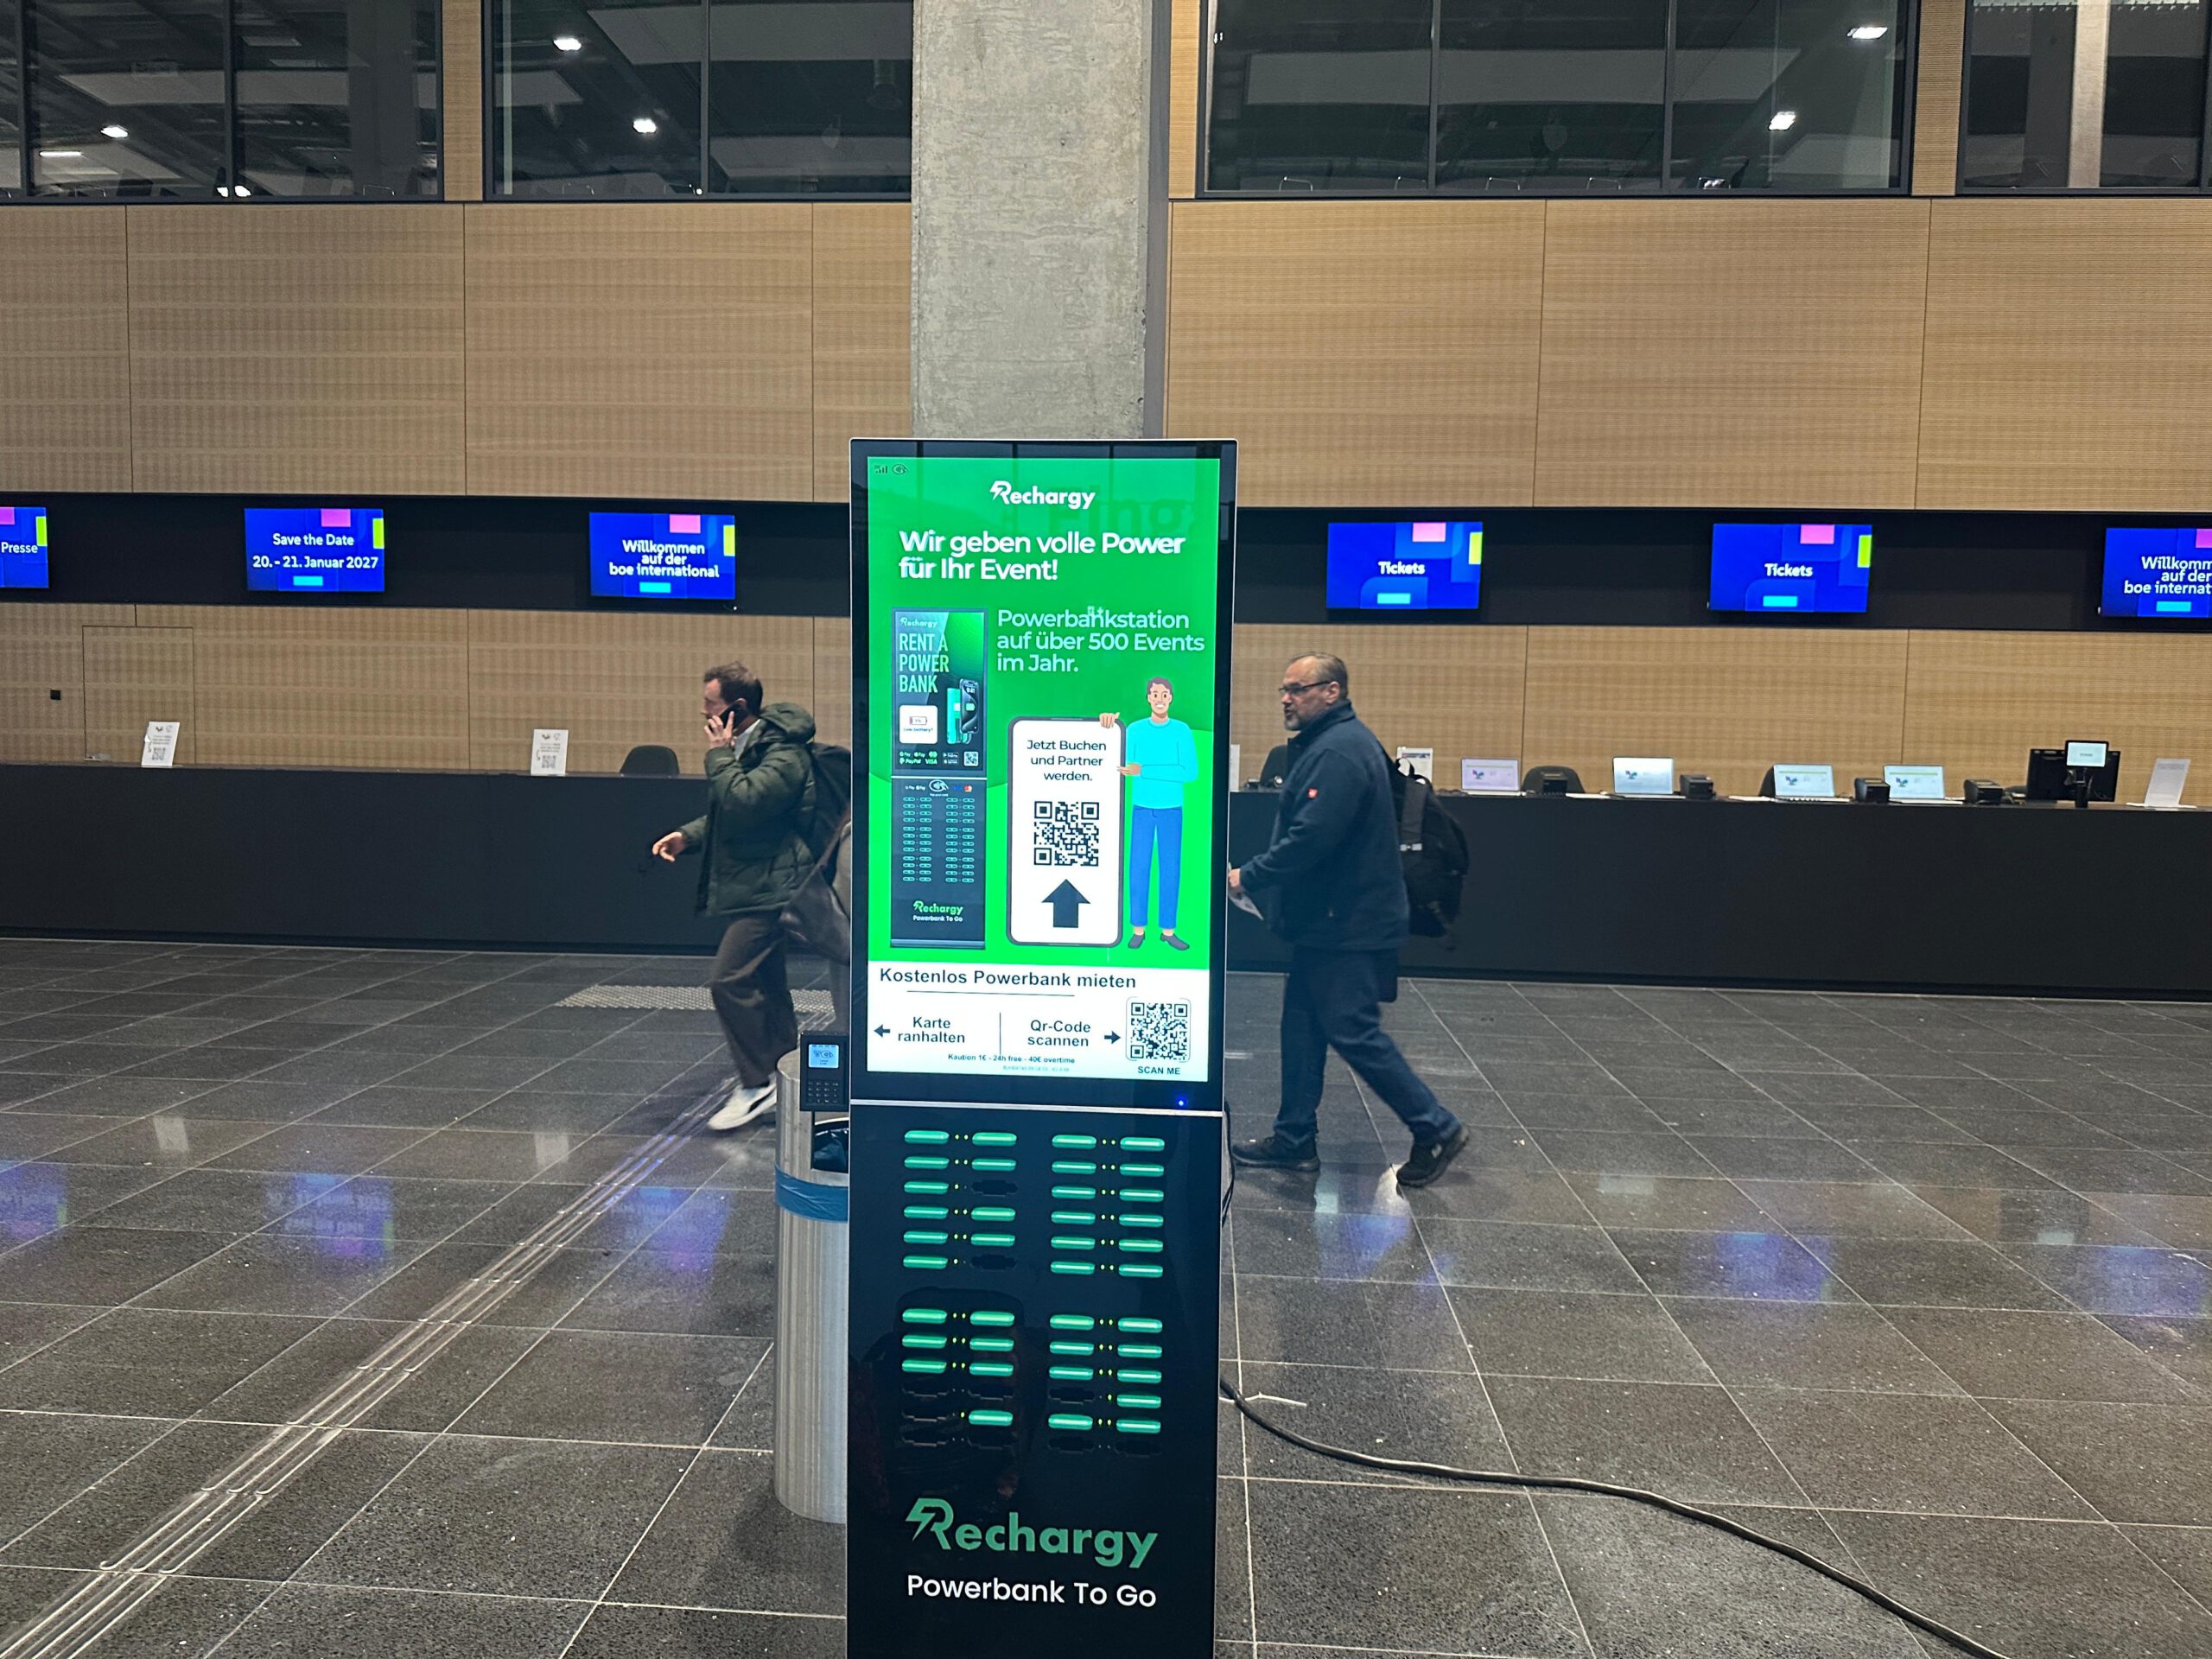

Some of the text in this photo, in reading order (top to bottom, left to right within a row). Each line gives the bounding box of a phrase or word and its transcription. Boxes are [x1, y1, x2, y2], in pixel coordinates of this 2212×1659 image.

[989, 480, 1096, 509] Rechargy
[272, 533, 354, 546] Save the Date
[622, 539, 705, 554] Willkommen
[899, 529, 1185, 557] Wir geben volle Power
[1, 541, 38, 553] Presse
[283, 556, 302, 568] 21.
[304, 556, 345, 568] Januar
[346, 556, 378, 569] 2027
[641, 552, 687, 565] auf der
[609, 562, 720, 578] boe international
[899, 556, 1058, 580] für Ihr Event!
[1377, 561, 1426, 575] Tickets
[1764, 563, 1813, 576] Tickets
[2161, 569, 2212, 582] auf der
[2124, 580, 2152, 594] boe
[899, 617, 938, 628] Rechargy
[997, 609, 1189, 629] Powerbankstation
[899, 632, 949, 652] RENT A
[997, 631, 1205, 652] auf über 500 Events
[899, 653, 950, 672] POWER
[997, 652, 1079, 672] im Jahr.
[899, 674, 938, 693] BANK
[1027, 740, 1107, 751] Jetzt Buchen
[1030, 755, 1103, 766] und Partner
[1043, 771, 1093, 781] werden.
[912, 900, 963, 916] Rechargy
[880, 968, 1136, 988] Kostenlos Powerbank mieten
[912, 1016, 951, 1029] Karte
[1030, 1020, 1091, 1033] Qr-Code
[898, 1030, 965, 1043] ranhalten
[1027, 1035, 1089, 1047] scannen
[1137, 1065, 1181, 1076] SCAN ME
[906, 1497, 1158, 1568] Rechargy
[907, 1574, 1157, 1607] Powerbank To Go
